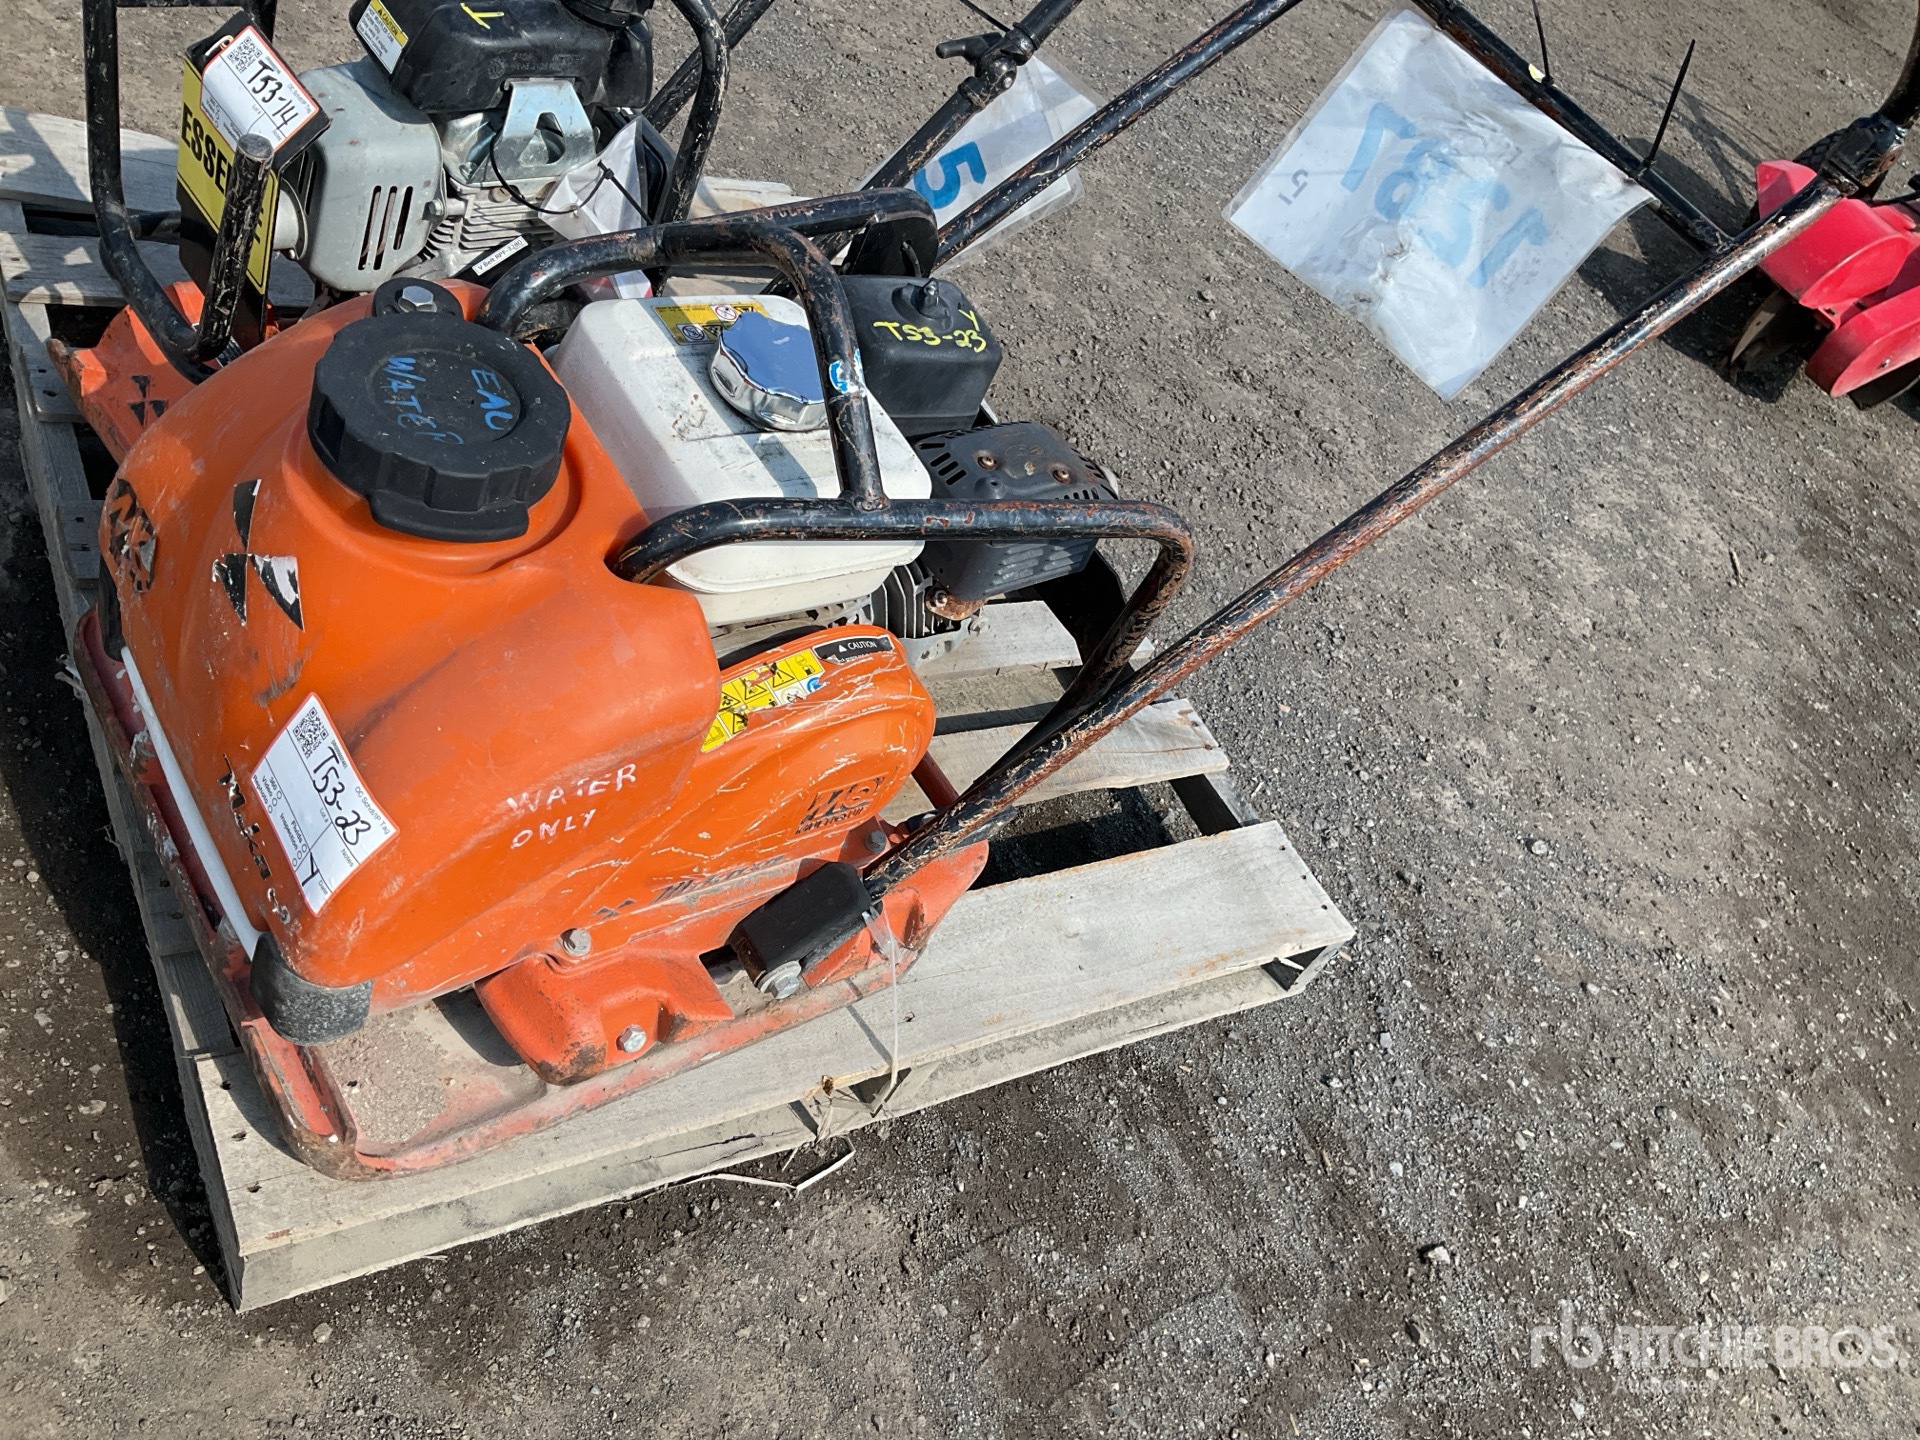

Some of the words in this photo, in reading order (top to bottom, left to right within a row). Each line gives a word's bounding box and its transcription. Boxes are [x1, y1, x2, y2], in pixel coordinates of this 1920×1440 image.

[382, 13, 398, 36] CAUTION
[247, 59, 299, 130] T53-14
[482, 256, 495, 268] Belt
[847, 640, 878, 651] CAUTION
[262, 775, 273, 797] Video
[313, 746, 372, 846] T53-23
[506, 763, 636, 813] WATER
[279, 812, 298, 851] Inspection
[290, 820, 303, 844] Fluids
[379, 820, 391, 836] Tag
[510, 808, 597, 850] ONLY
[340, 848, 354, 868] Notes
[318, 879, 328, 895] Date
